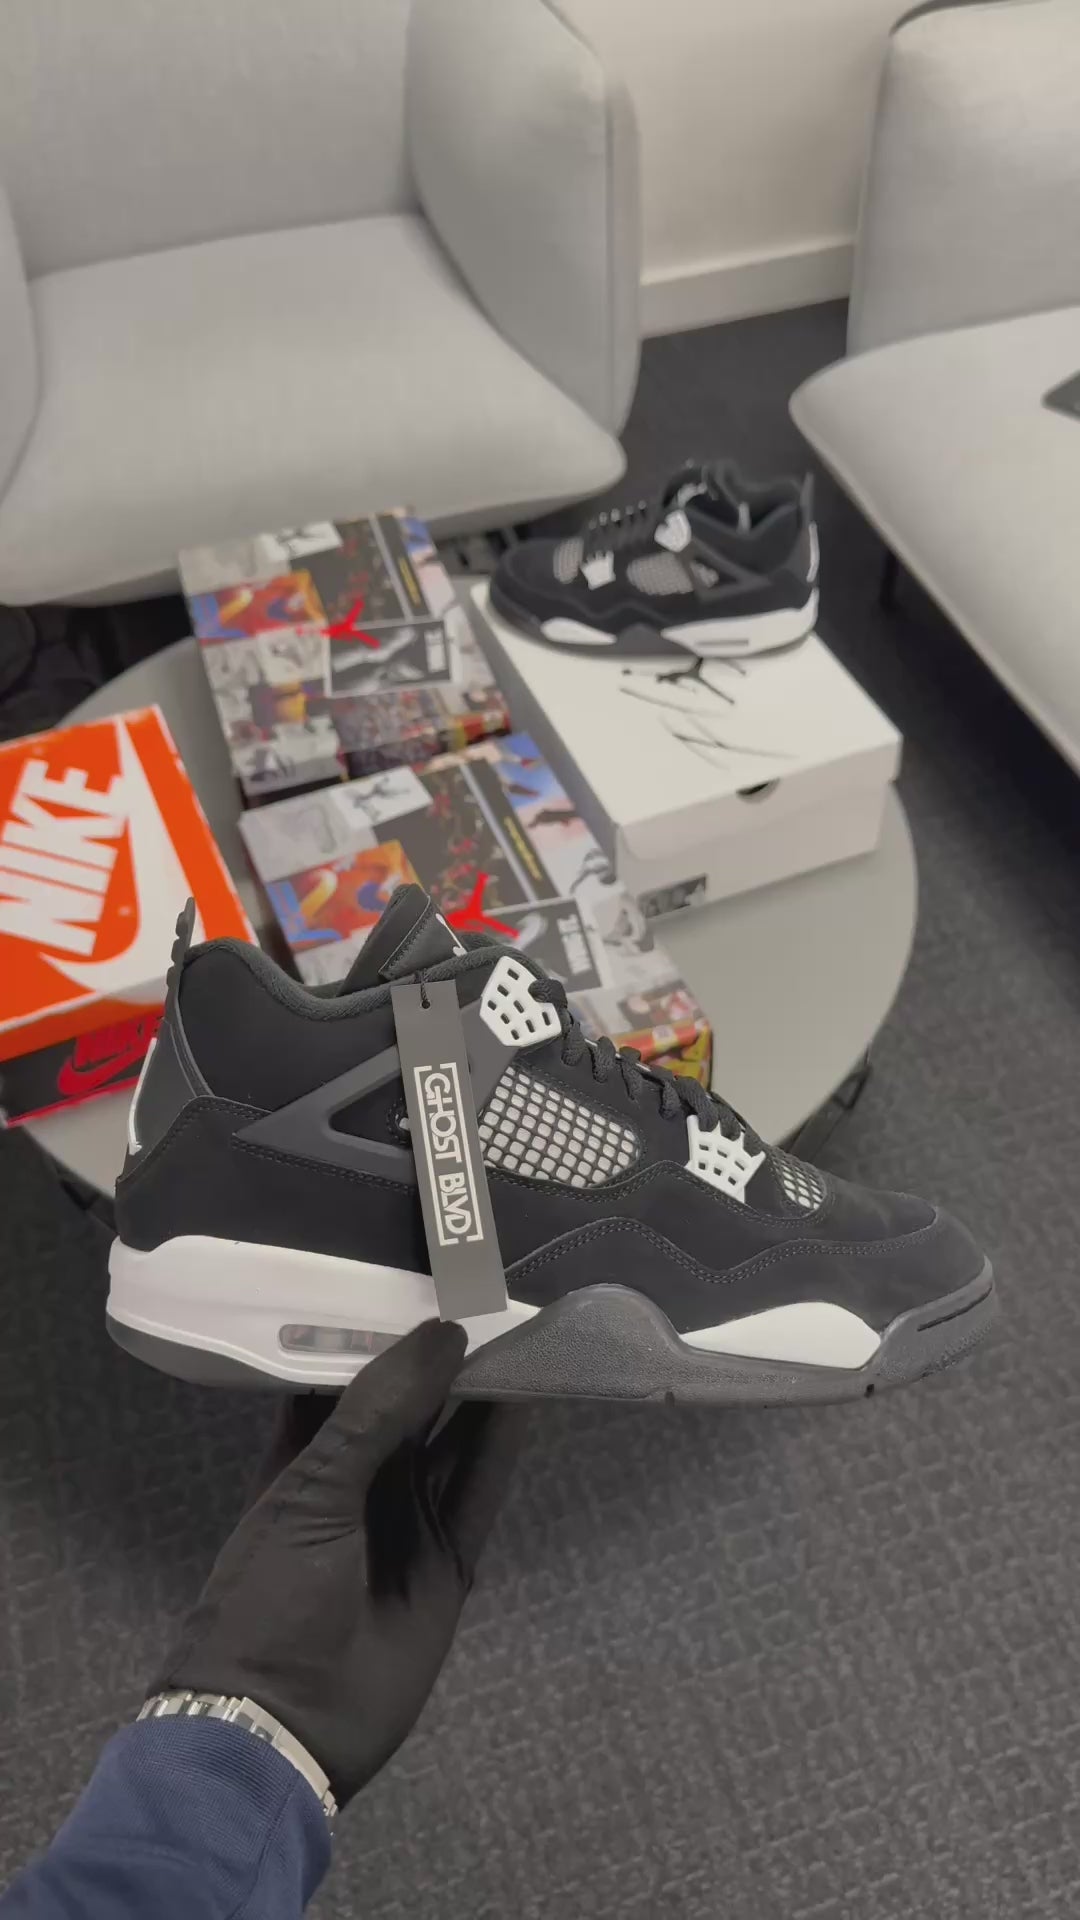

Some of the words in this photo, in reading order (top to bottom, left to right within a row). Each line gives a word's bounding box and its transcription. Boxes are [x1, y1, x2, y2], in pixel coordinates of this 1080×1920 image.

[0, 758, 127, 957] NIKE
[424, 1072, 463, 1164] GHOST
[438, 1172, 472, 1235] BLVD
